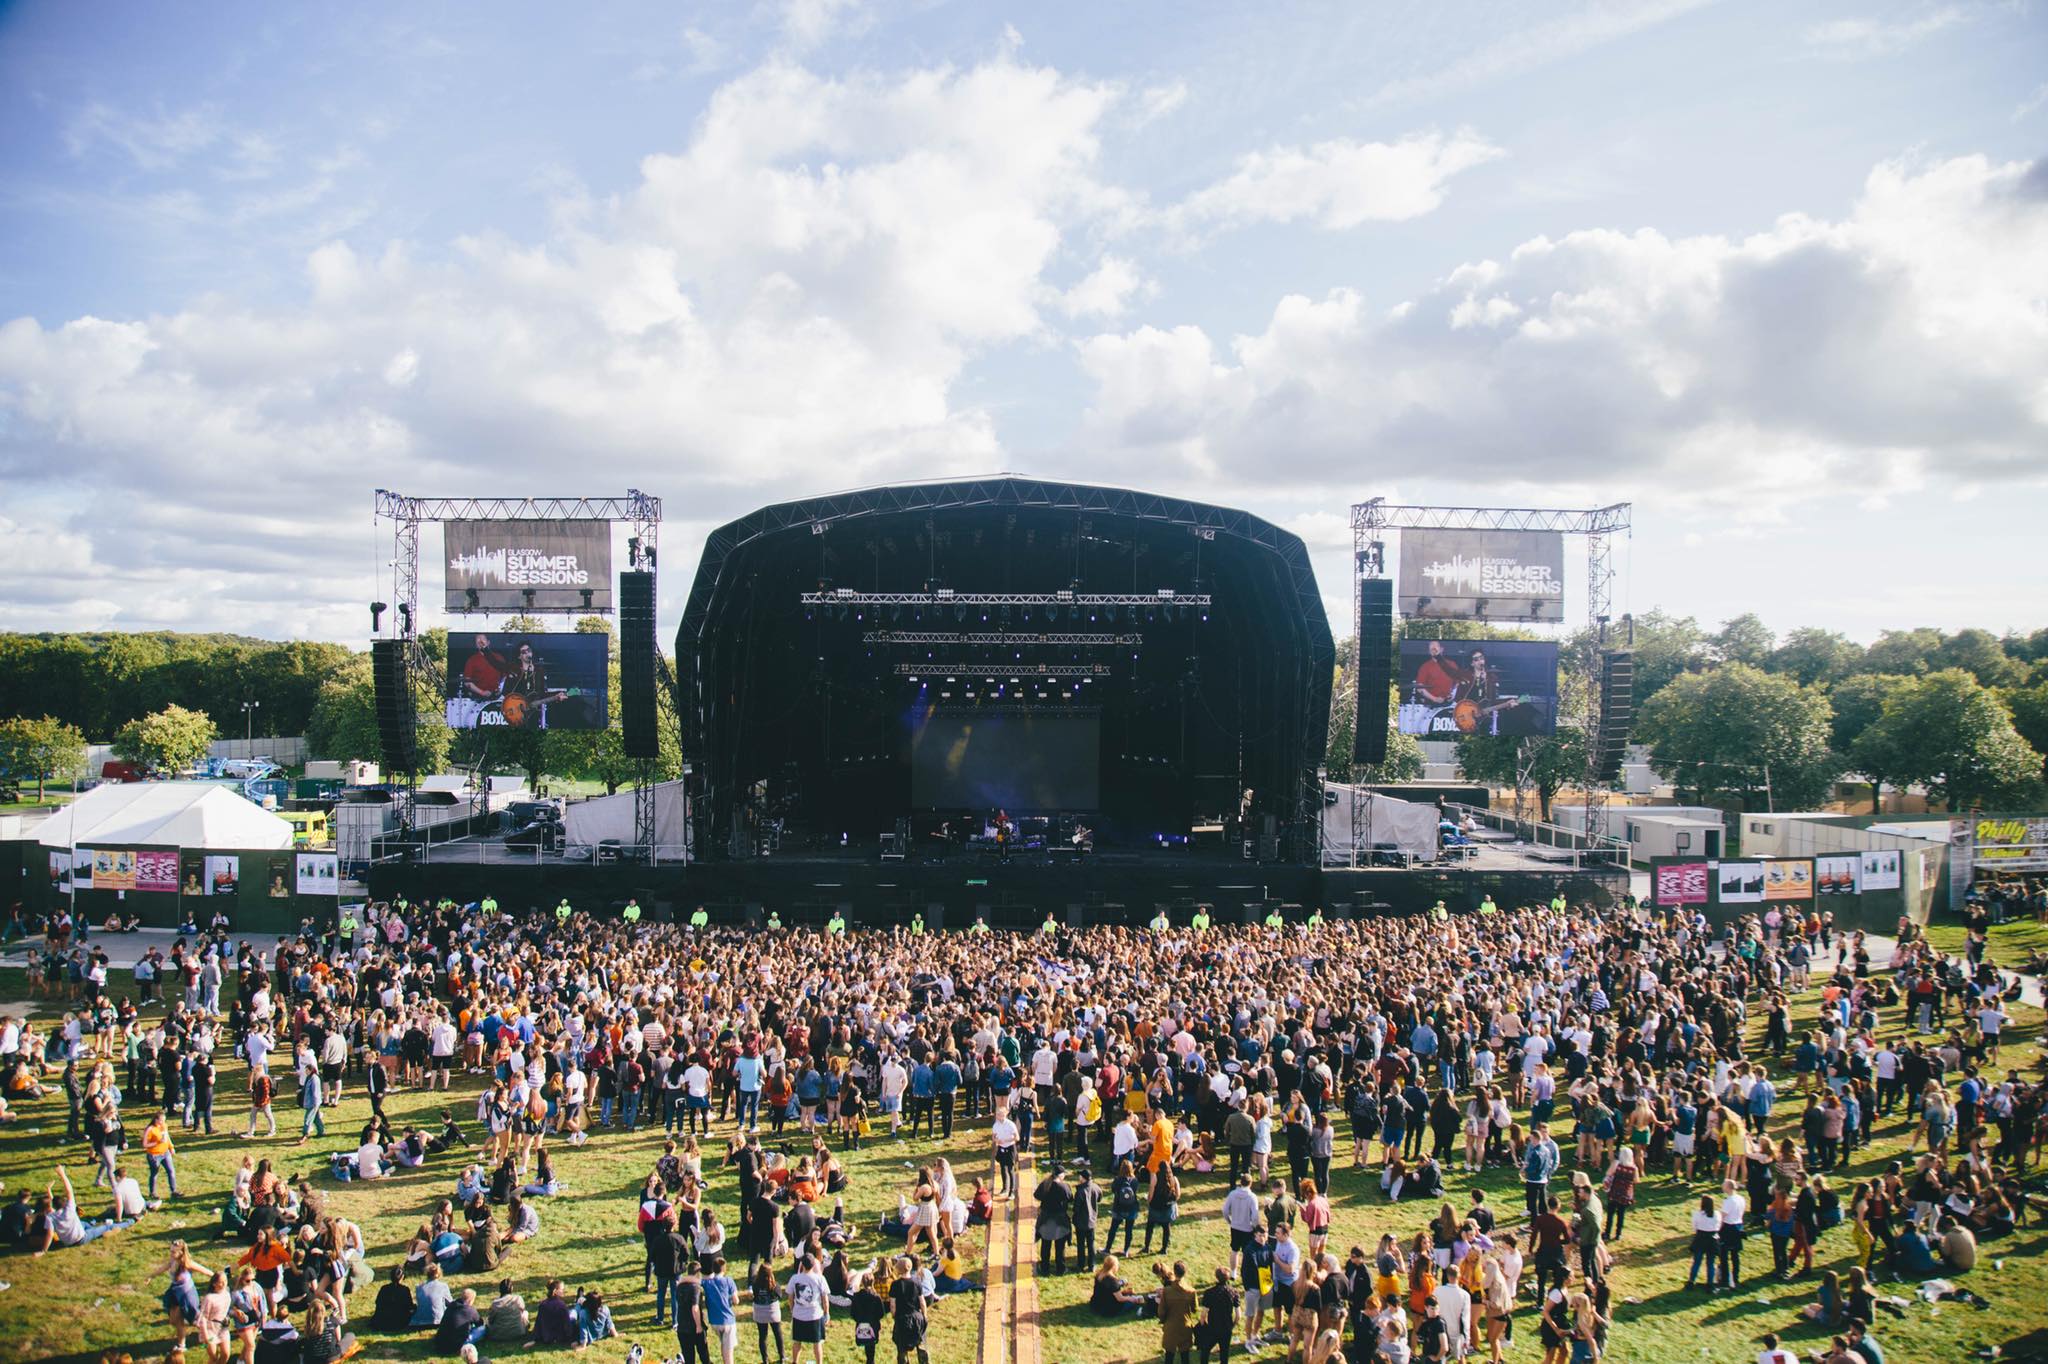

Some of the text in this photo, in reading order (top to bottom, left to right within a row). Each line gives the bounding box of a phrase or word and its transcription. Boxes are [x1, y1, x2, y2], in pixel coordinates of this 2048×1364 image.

[507, 555, 579, 570] SUMMER
[507, 570, 589, 585] SESSIONS
[1481, 565, 1552, 580] SUMMER
[1481, 579, 1562, 594] SESSIONS
[1976, 820, 2028, 844] Philly
